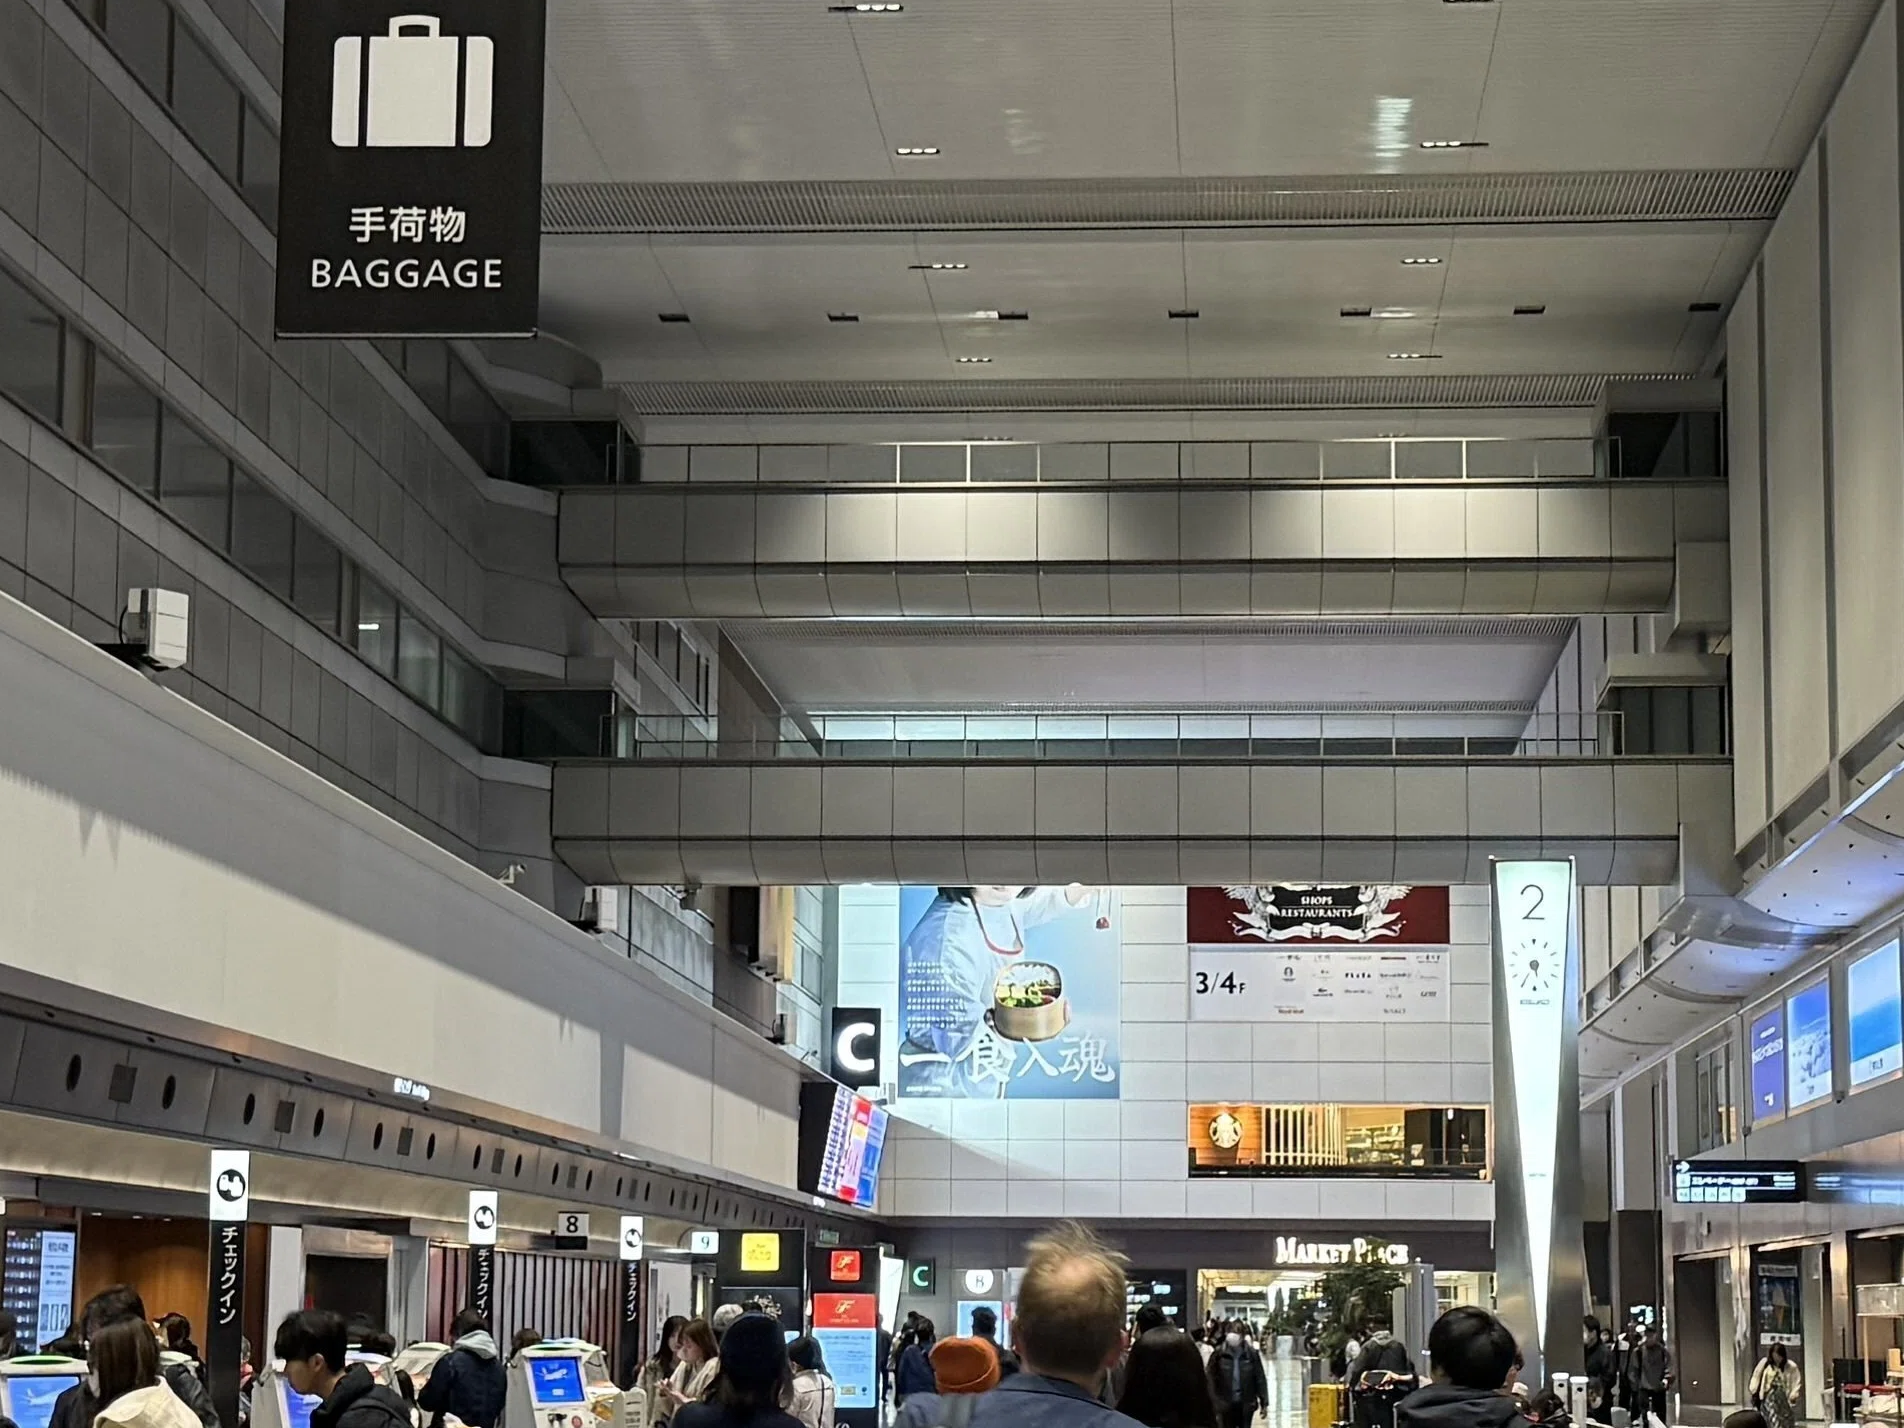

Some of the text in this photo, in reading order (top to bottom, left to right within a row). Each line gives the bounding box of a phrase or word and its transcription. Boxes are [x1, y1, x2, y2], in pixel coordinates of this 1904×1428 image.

[349, 206, 466, 244] 手荷物
[311, 259, 503, 289] BAGGAGE
[1280, 908, 1353, 918] RESTAURANTS
[1520, 883, 1546, 921] 2
[837, 1021, 876, 1073] C
[899, 1031, 1116, 1084] 一食入魂
[566, 1216, 579, 1233] 8
[700, 1235, 710, 1250] 9
[219, 1226, 239, 1324] チェックイン
[912, 1265, 929, 1287] C
